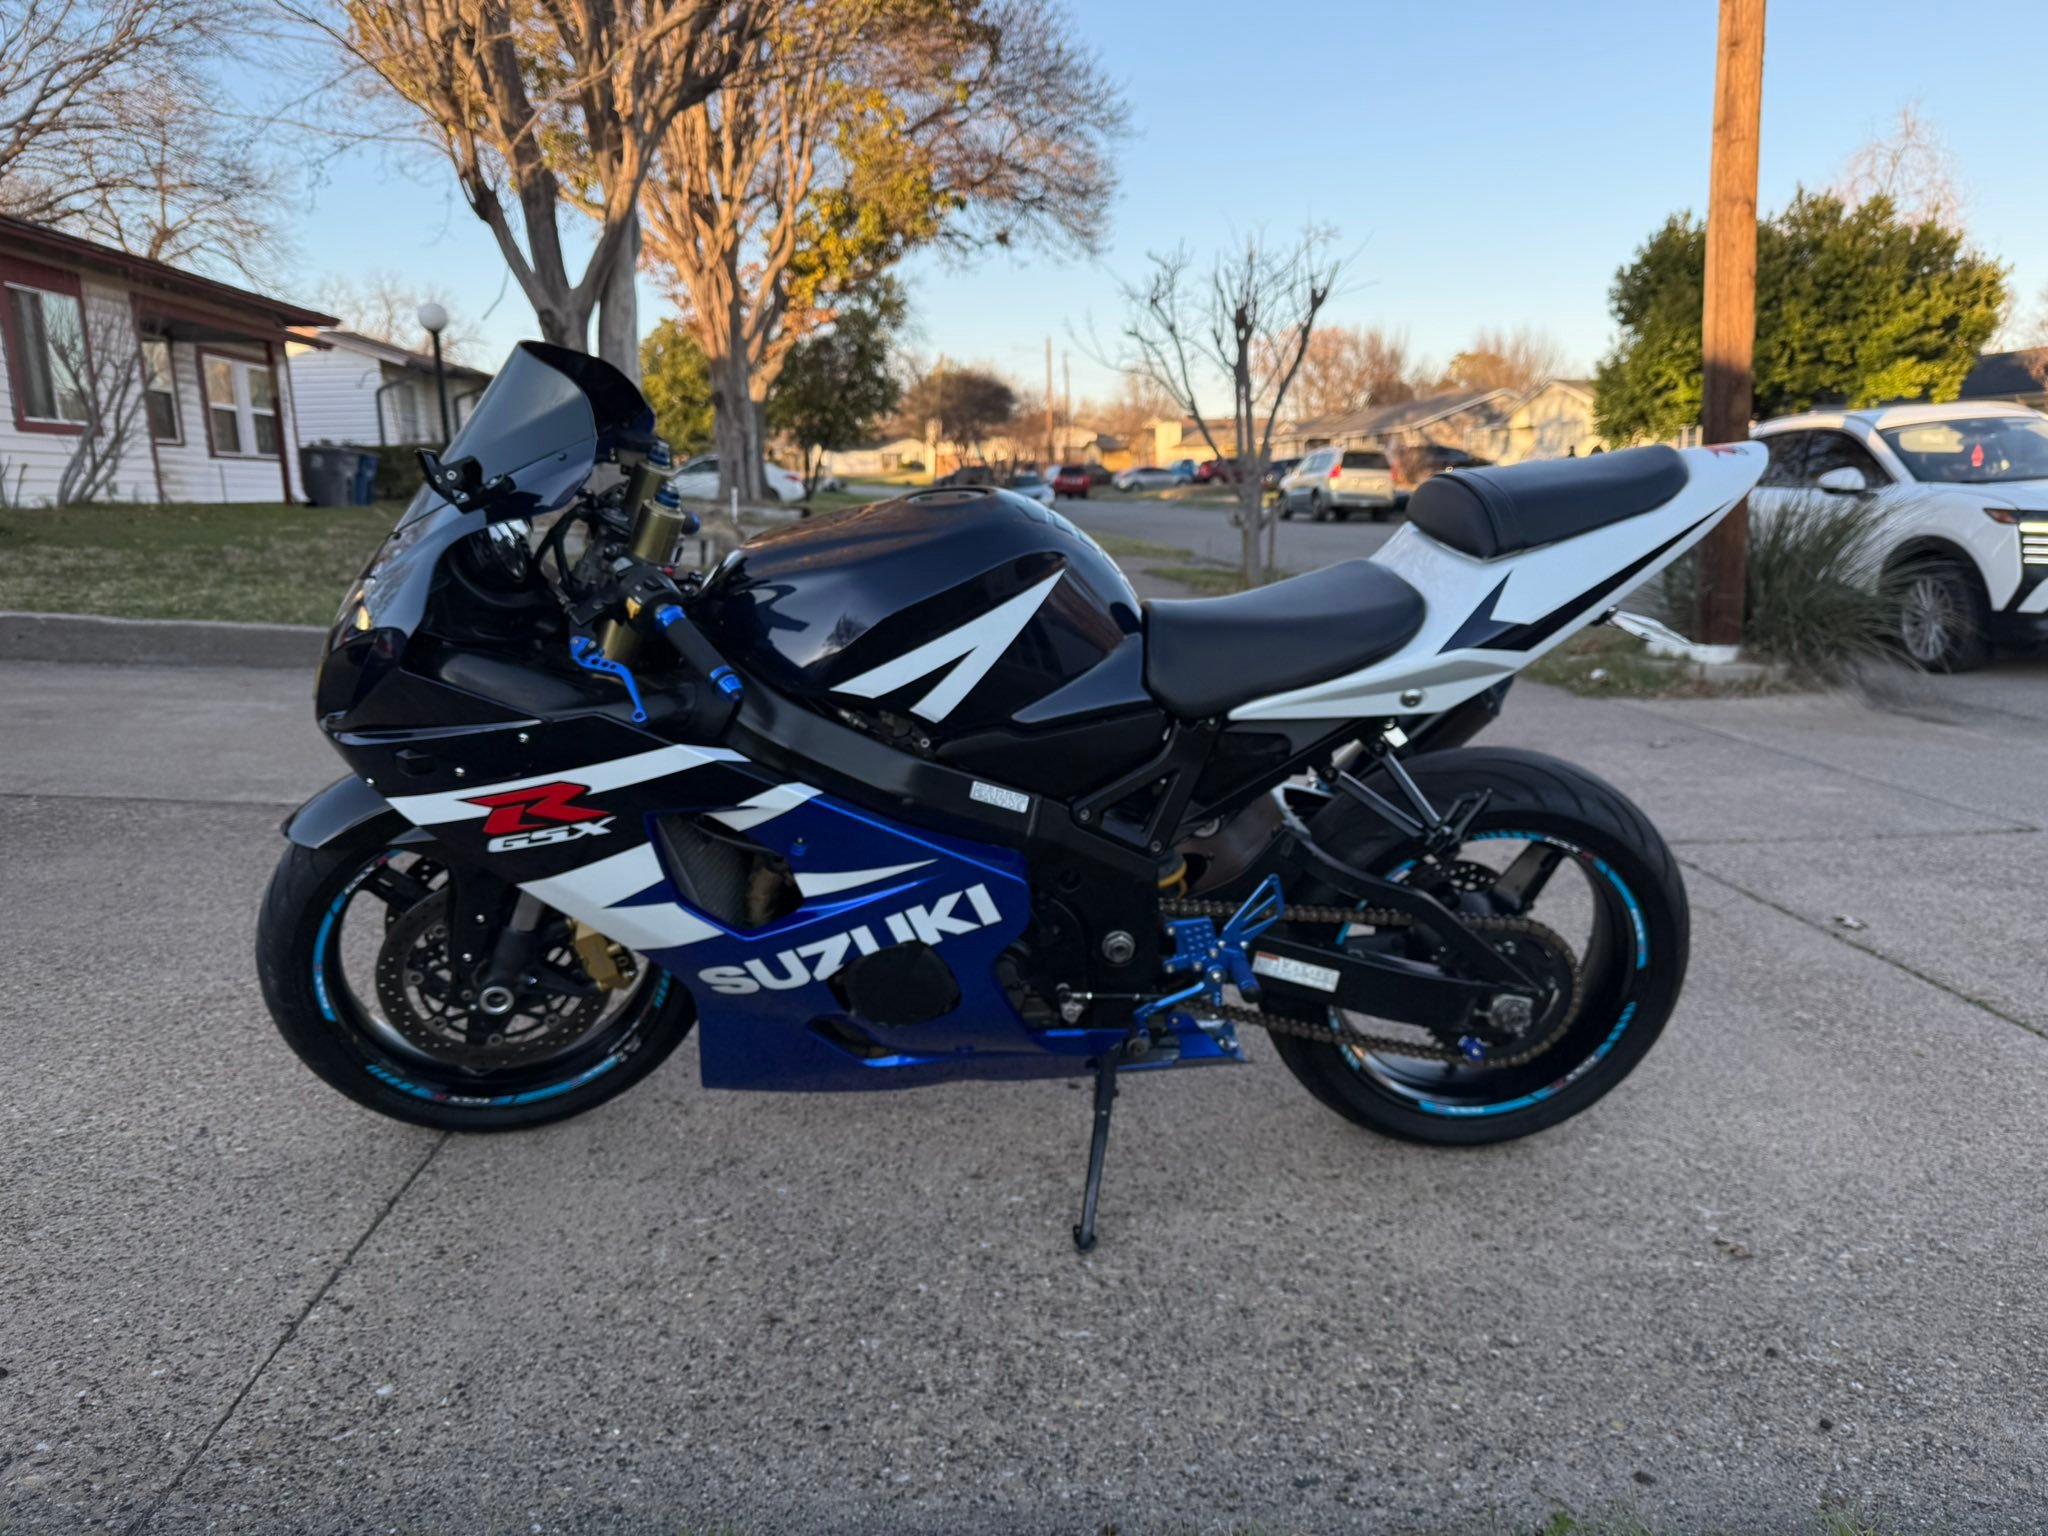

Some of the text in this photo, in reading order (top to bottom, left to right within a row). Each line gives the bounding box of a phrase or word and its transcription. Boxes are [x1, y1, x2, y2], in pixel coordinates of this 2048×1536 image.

[462, 781, 612, 836] R
[487, 816, 618, 853] GSX
[697, 882, 1003, 995] SUZUKI
